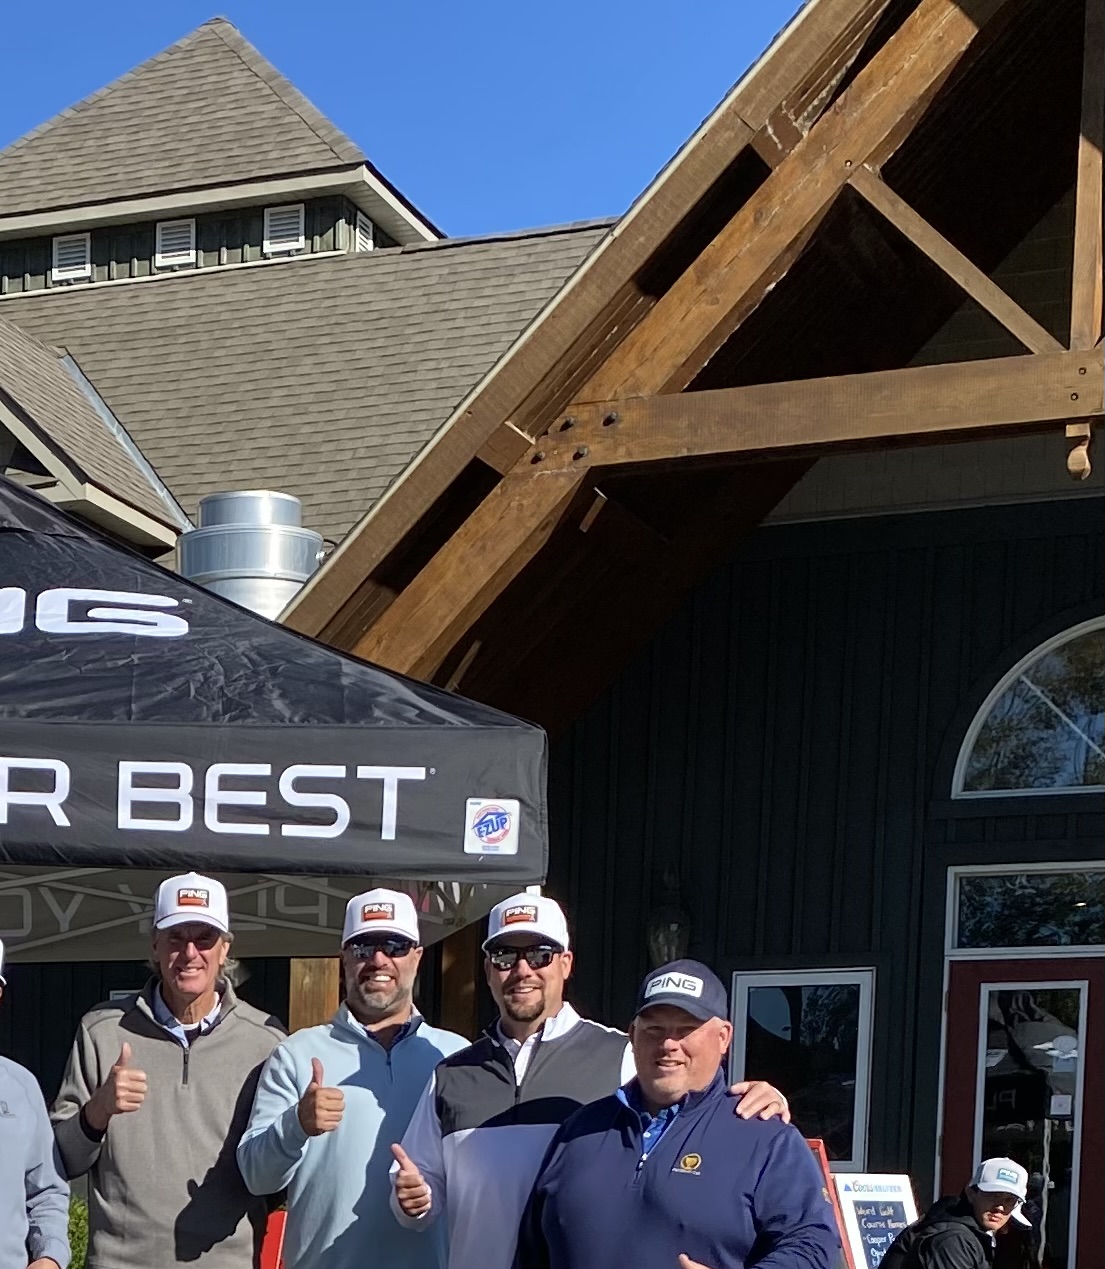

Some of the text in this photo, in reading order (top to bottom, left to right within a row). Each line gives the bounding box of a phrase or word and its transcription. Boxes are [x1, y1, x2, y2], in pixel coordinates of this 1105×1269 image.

[117, 760, 427, 841] BEST
[179, 889, 208, 899] PING
[364, 903, 393, 913] PING
[505, 906, 536, 917] PING
[648, 976, 697, 992] PING
